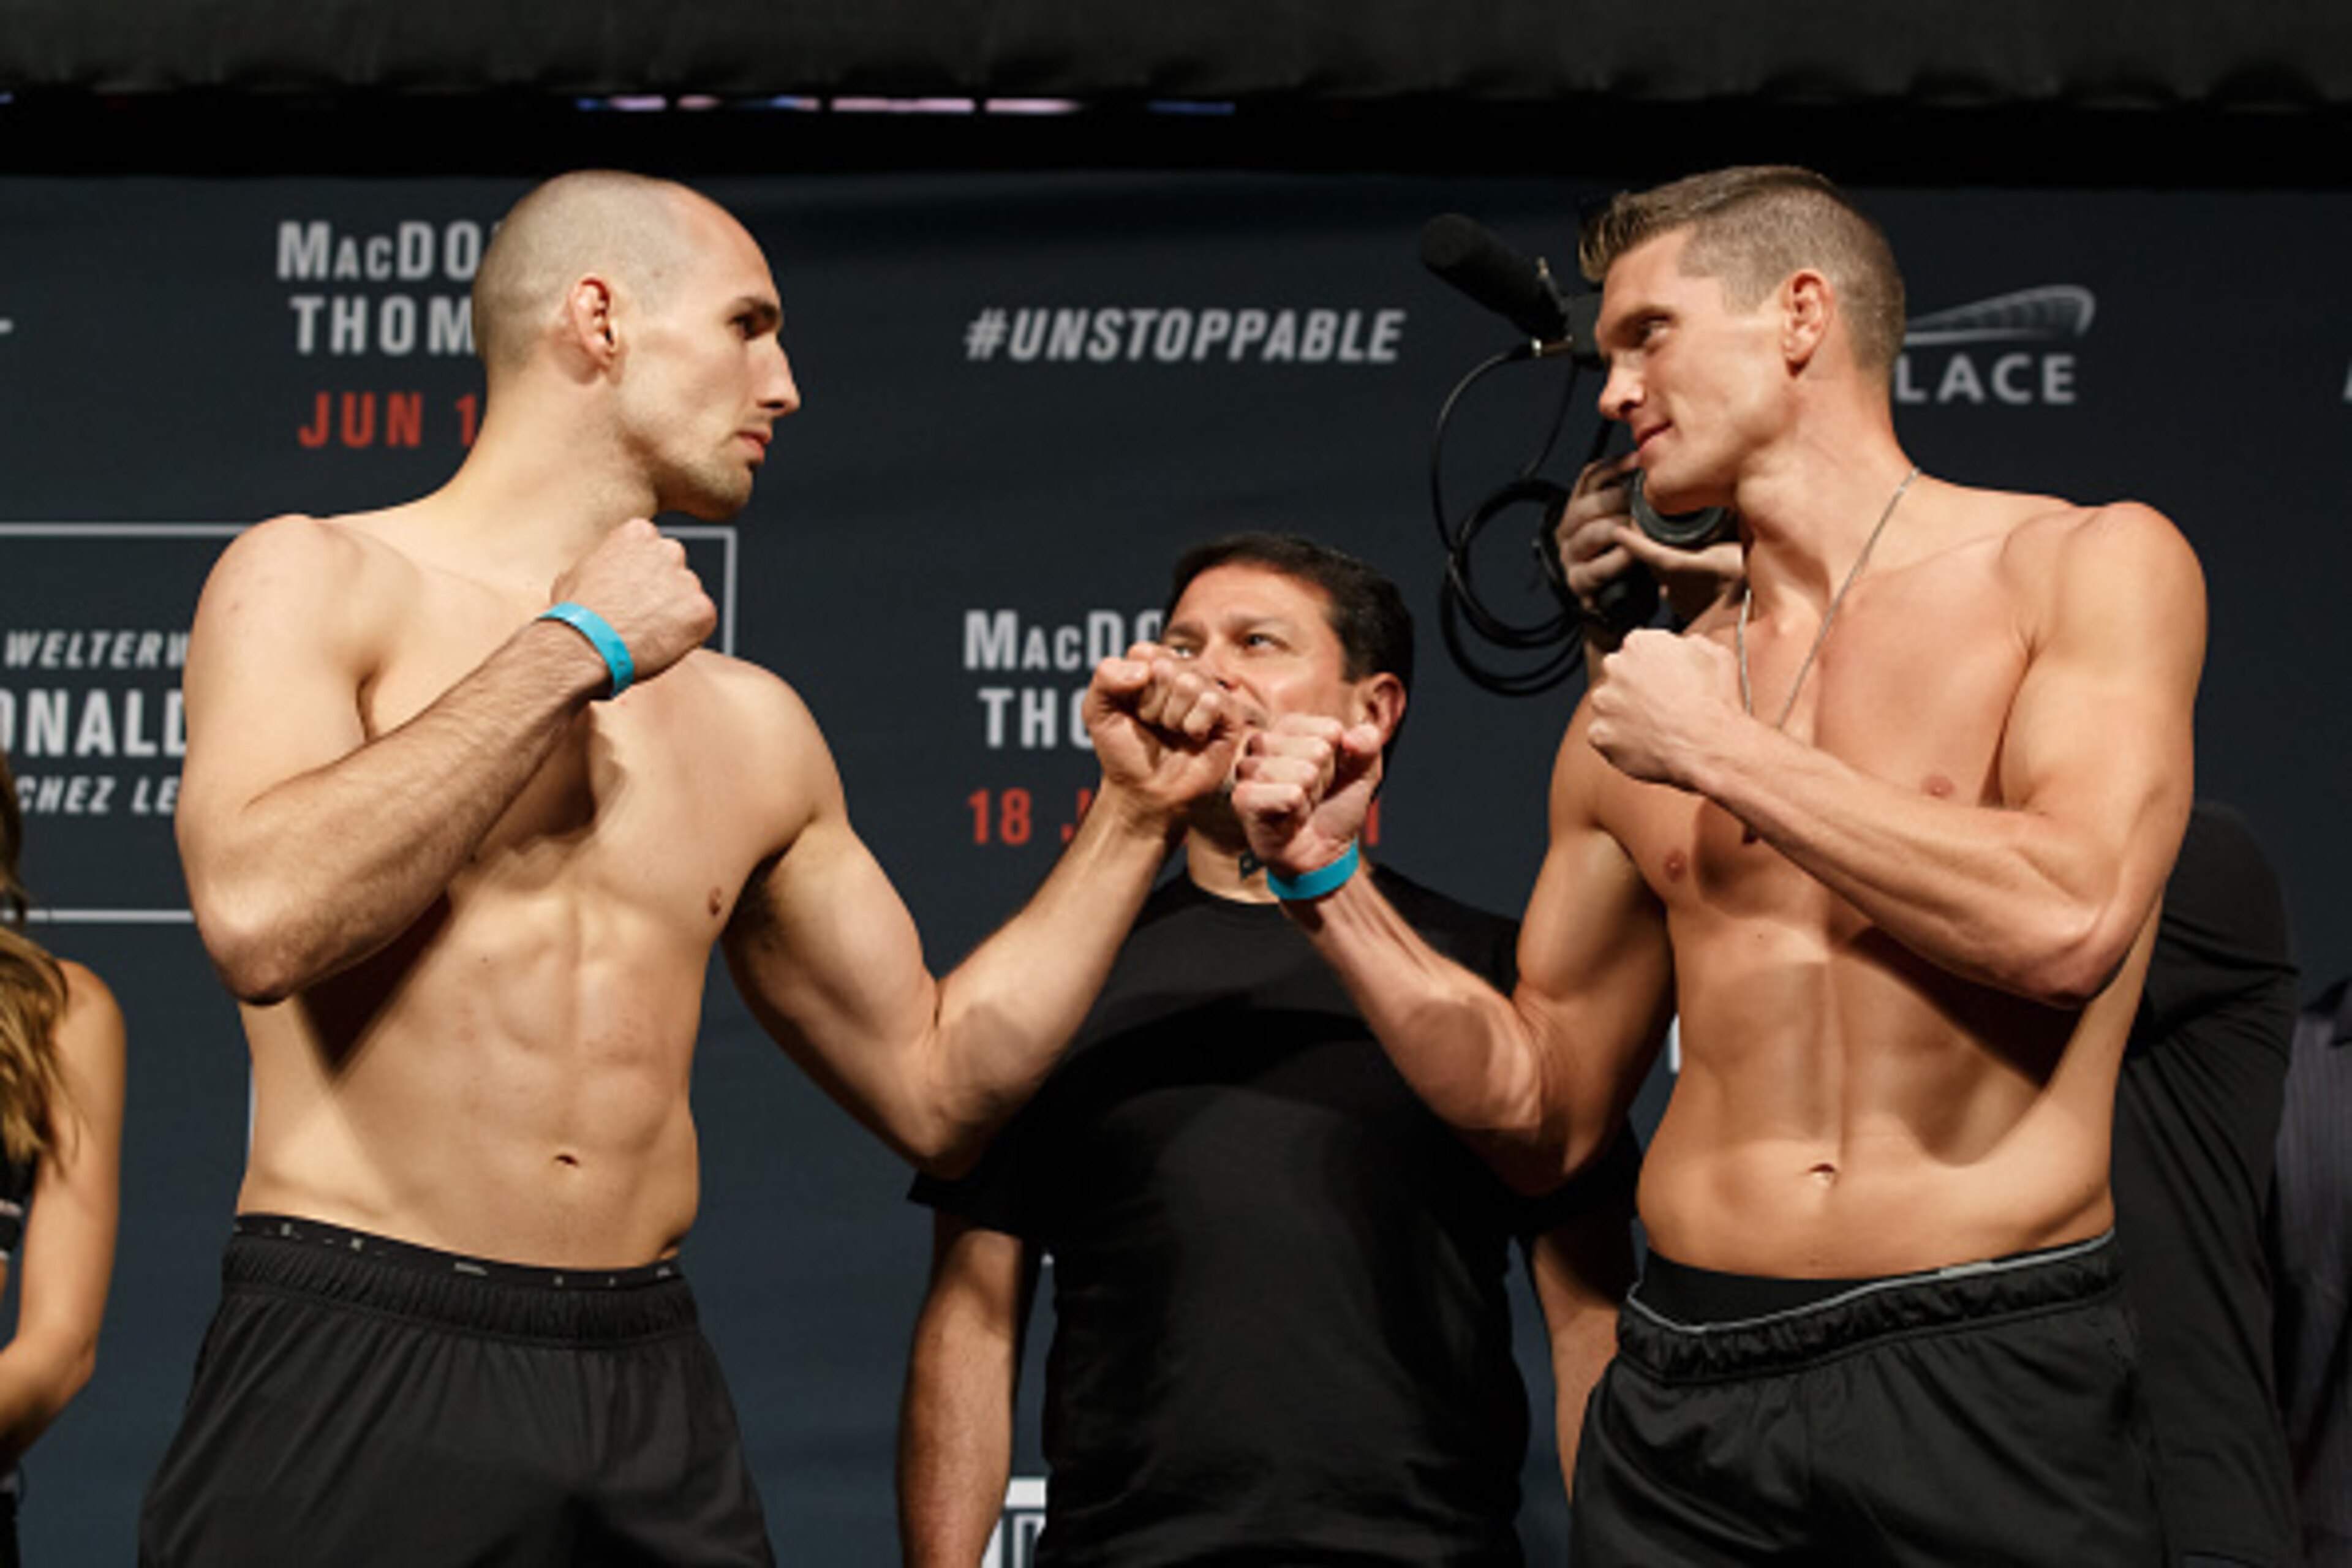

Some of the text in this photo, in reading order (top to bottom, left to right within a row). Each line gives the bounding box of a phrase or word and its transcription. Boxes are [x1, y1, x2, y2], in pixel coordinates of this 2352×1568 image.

[278, 221, 502, 280] MACDO
[290, 296, 477, 355] THOM
[965, 307, 1404, 361] #UNSTOPPABLE
[1896, 353, 2076, 404] LACE
[298, 392, 421, 448] JUN
[16, 775, 116, 813] CHEZ
[968, 788, 1031, 845] 18
